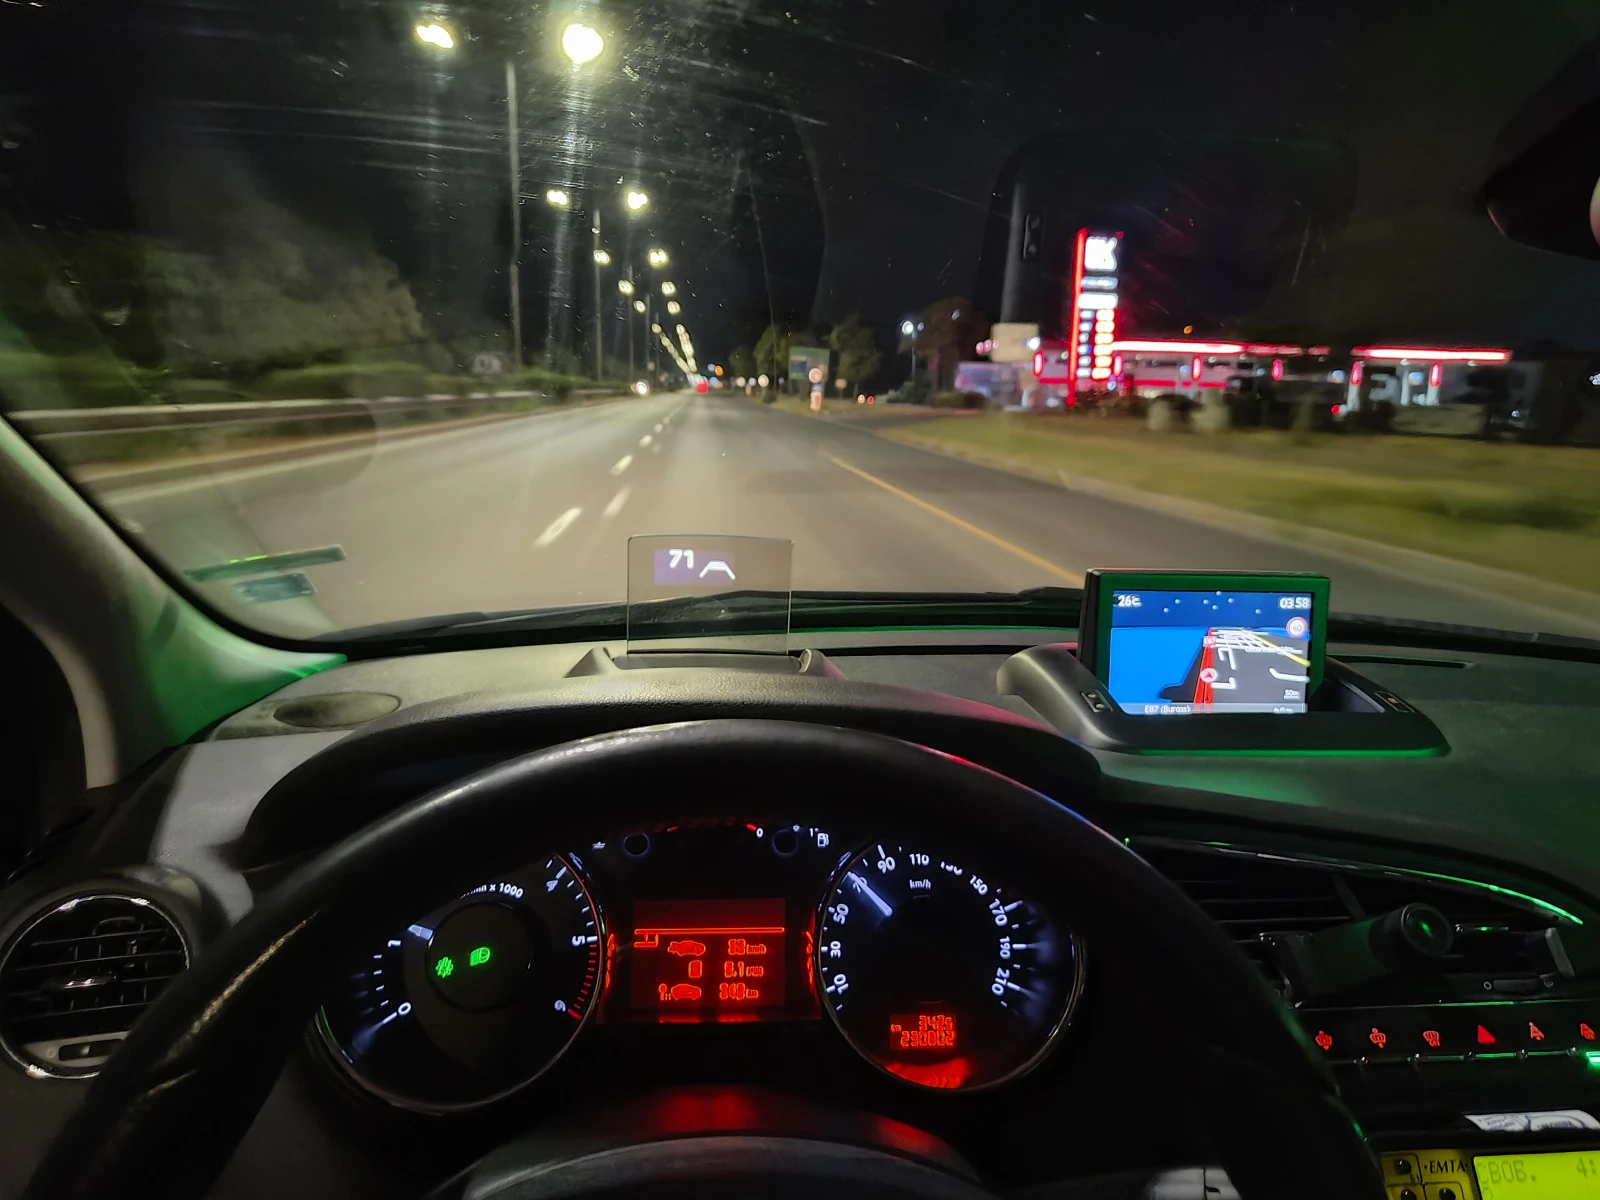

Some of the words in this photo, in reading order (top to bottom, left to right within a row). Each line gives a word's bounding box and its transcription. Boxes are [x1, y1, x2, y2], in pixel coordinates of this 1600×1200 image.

[669, 549, 694, 569] 71
[877, 856, 896, 874] 90
[909, 853, 930, 866] 110
[499, 882, 523, 899] 1000
[909, 879, 931, 890] km/h
[969, 874, 989, 895] 150
[833, 903, 849, 925] 50
[989, 898, 1008, 927] 170
[571, 935, 585, 947] 5
[830, 941, 841, 958] 30
[999, 936, 1011, 960] 190
[991, 967, 1010, 995] 210
[397, 1001, 412, 1015] 0
